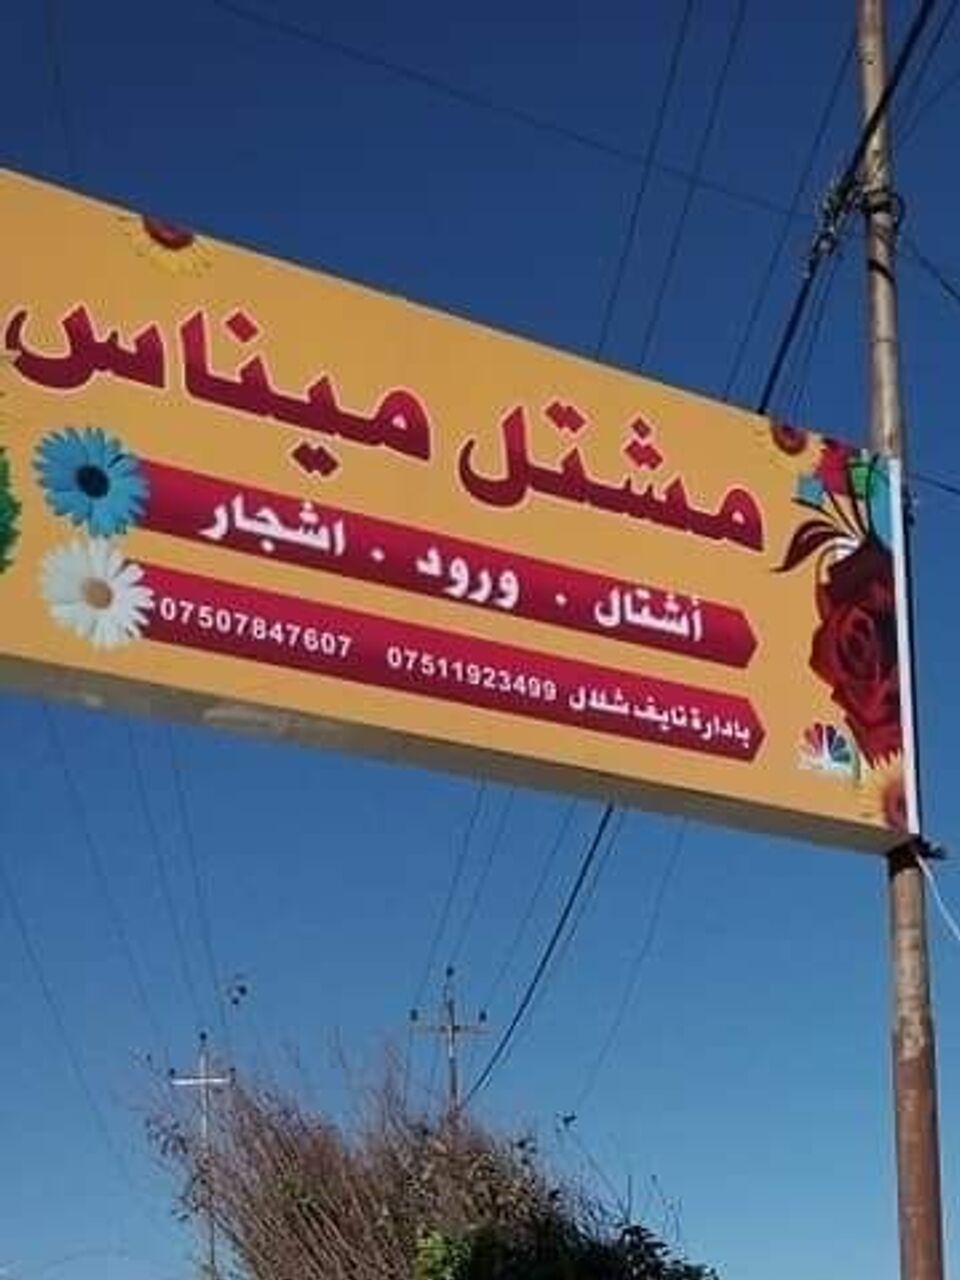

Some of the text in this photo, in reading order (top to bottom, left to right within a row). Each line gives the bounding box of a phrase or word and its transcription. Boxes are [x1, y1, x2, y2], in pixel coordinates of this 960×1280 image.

[4, 303, 766, 553] مشتل ميناس
[201, 495, 345, 555] اشجار
[415, 548, 519, 608] ورود
[160, 598, 352, 657] 07507847607
[386, 645, 557, 701] 07511923499
